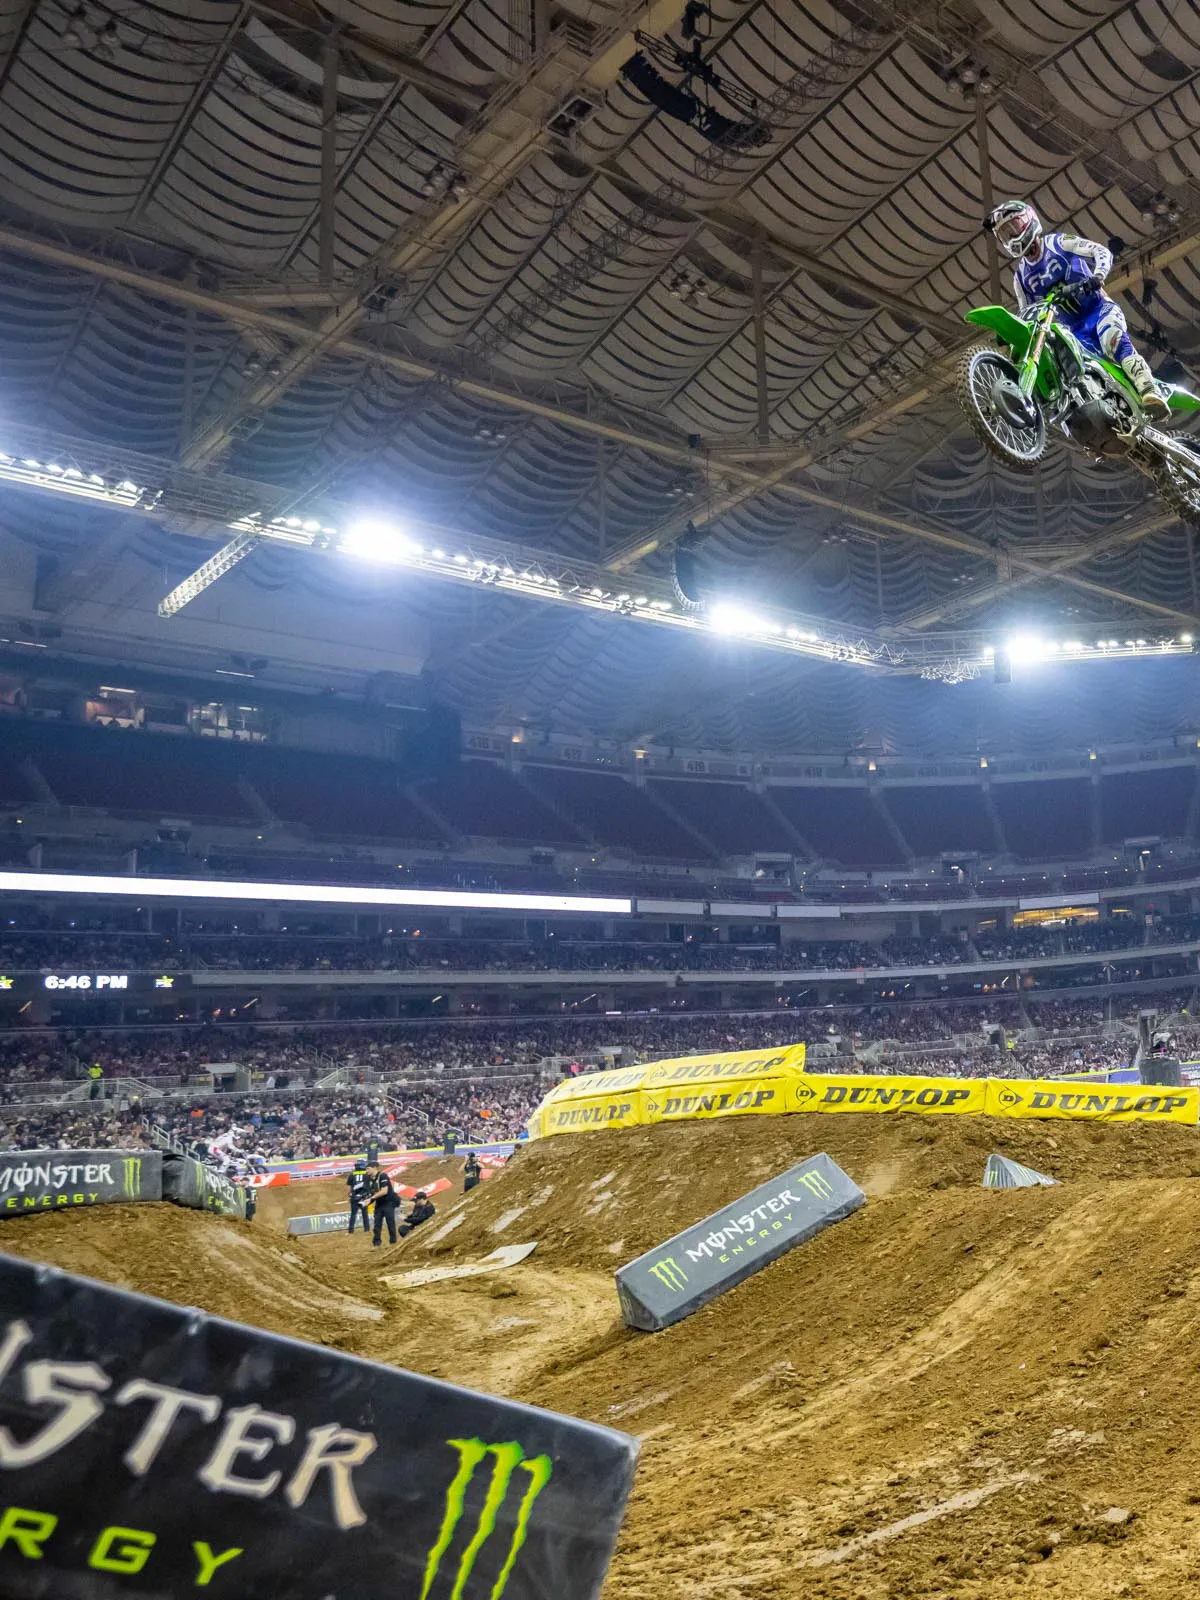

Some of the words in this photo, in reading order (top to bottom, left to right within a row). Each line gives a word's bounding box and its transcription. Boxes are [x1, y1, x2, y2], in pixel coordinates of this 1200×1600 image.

[44, 975, 91, 989] 6:46
[96, 975, 128, 989] PM
[667, 1056, 786, 1080] DUNLOP
[557, 1104, 632, 1126] DUNLOP
[661, 1090, 775, 1115] DUNLOP
[820, 1086, 971, 1106] DUNLOP
[1028, 1092, 1188, 1113] DUNLOP
[7, 1193, 99, 1208] ENERGY
[685, 1189, 801, 1263] MONSTER
[718, 1212, 795, 1264] ENERGY
